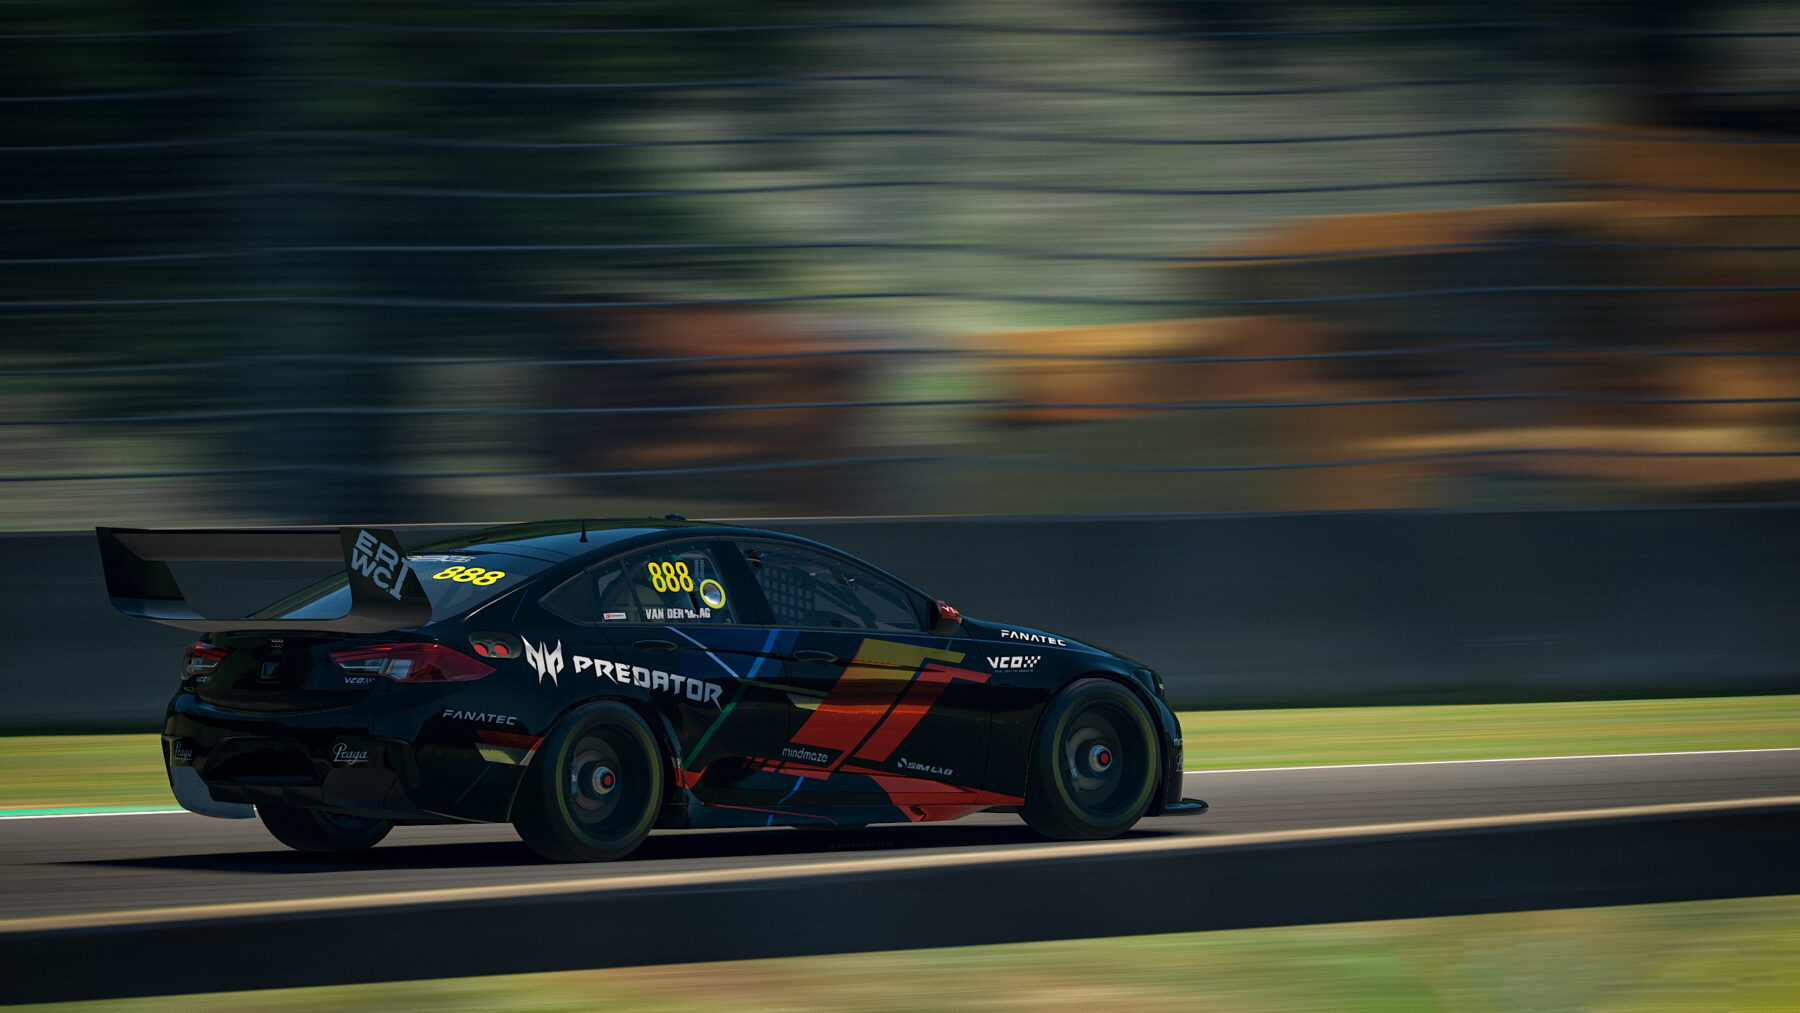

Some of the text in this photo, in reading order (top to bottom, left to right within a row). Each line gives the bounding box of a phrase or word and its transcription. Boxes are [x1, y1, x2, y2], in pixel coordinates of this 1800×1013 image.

[432, 565, 506, 586] 888
[648, 562, 694, 592] 888
[645, 608, 664, 619] VAN
[667, 608, 684, 619] DER
[1001, 629, 1067, 646] FANATEC
[987, 657, 1022, 668] VCO
[573, 655, 724, 710] PREDATOR
[443, 710, 517, 725] FANATEC
[333, 743, 368, 764] Praga
[782, 748, 829, 763] mindmaze
